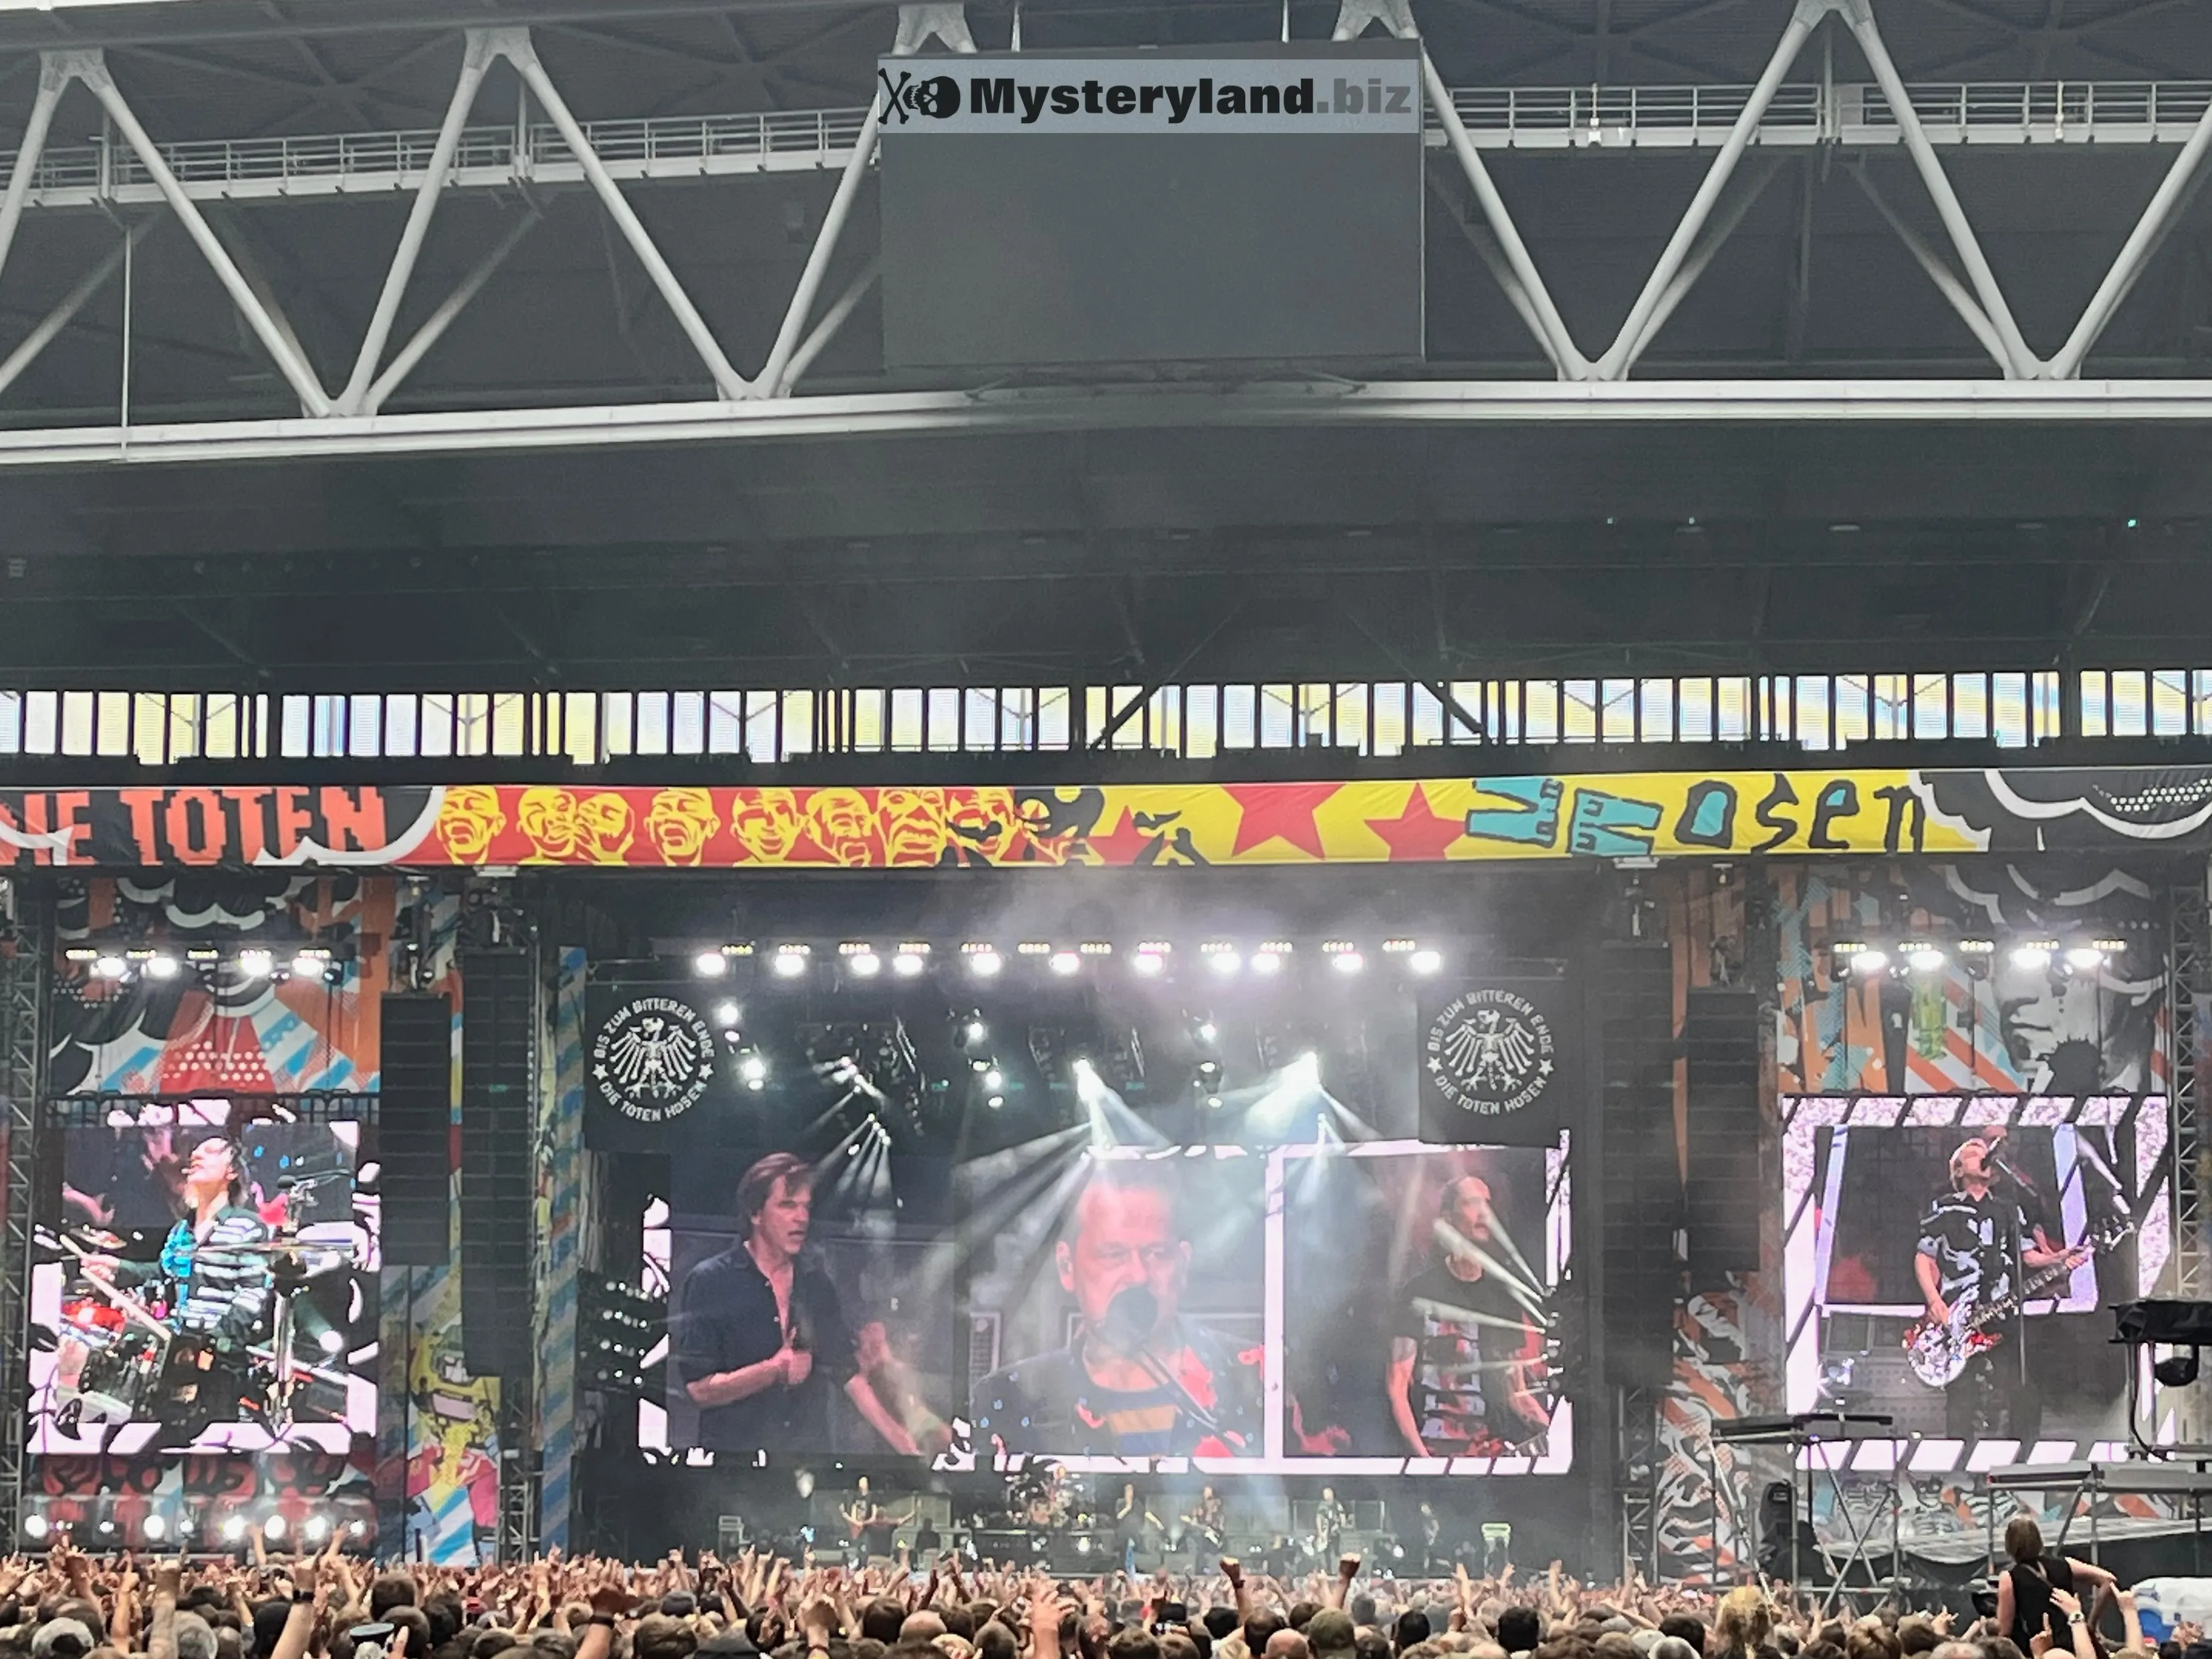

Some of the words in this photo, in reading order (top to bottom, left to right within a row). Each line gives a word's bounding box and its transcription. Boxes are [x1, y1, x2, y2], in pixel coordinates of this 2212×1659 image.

[120, 787, 386, 865] TOTEN
[603, 1005, 631, 1033] ZUM
[632, 998, 696, 1022] BITTEREN
[692, 1020, 714, 1058] ENDE
[1437, 999, 1465, 1026] ZUM
[1466, 990, 1533, 1015] BITTEREN
[1530, 1015, 1554, 1054] ENDE
[600, 1081, 622, 1106] DIE
[620, 1100, 661, 1122] TOTEN
[664, 1080, 707, 1118] HOSEN
[1435, 1075, 1459, 1100] DIE
[1457, 1094, 1500, 1114] TOTEN
[1504, 1076, 1546, 1112] HOSEN
